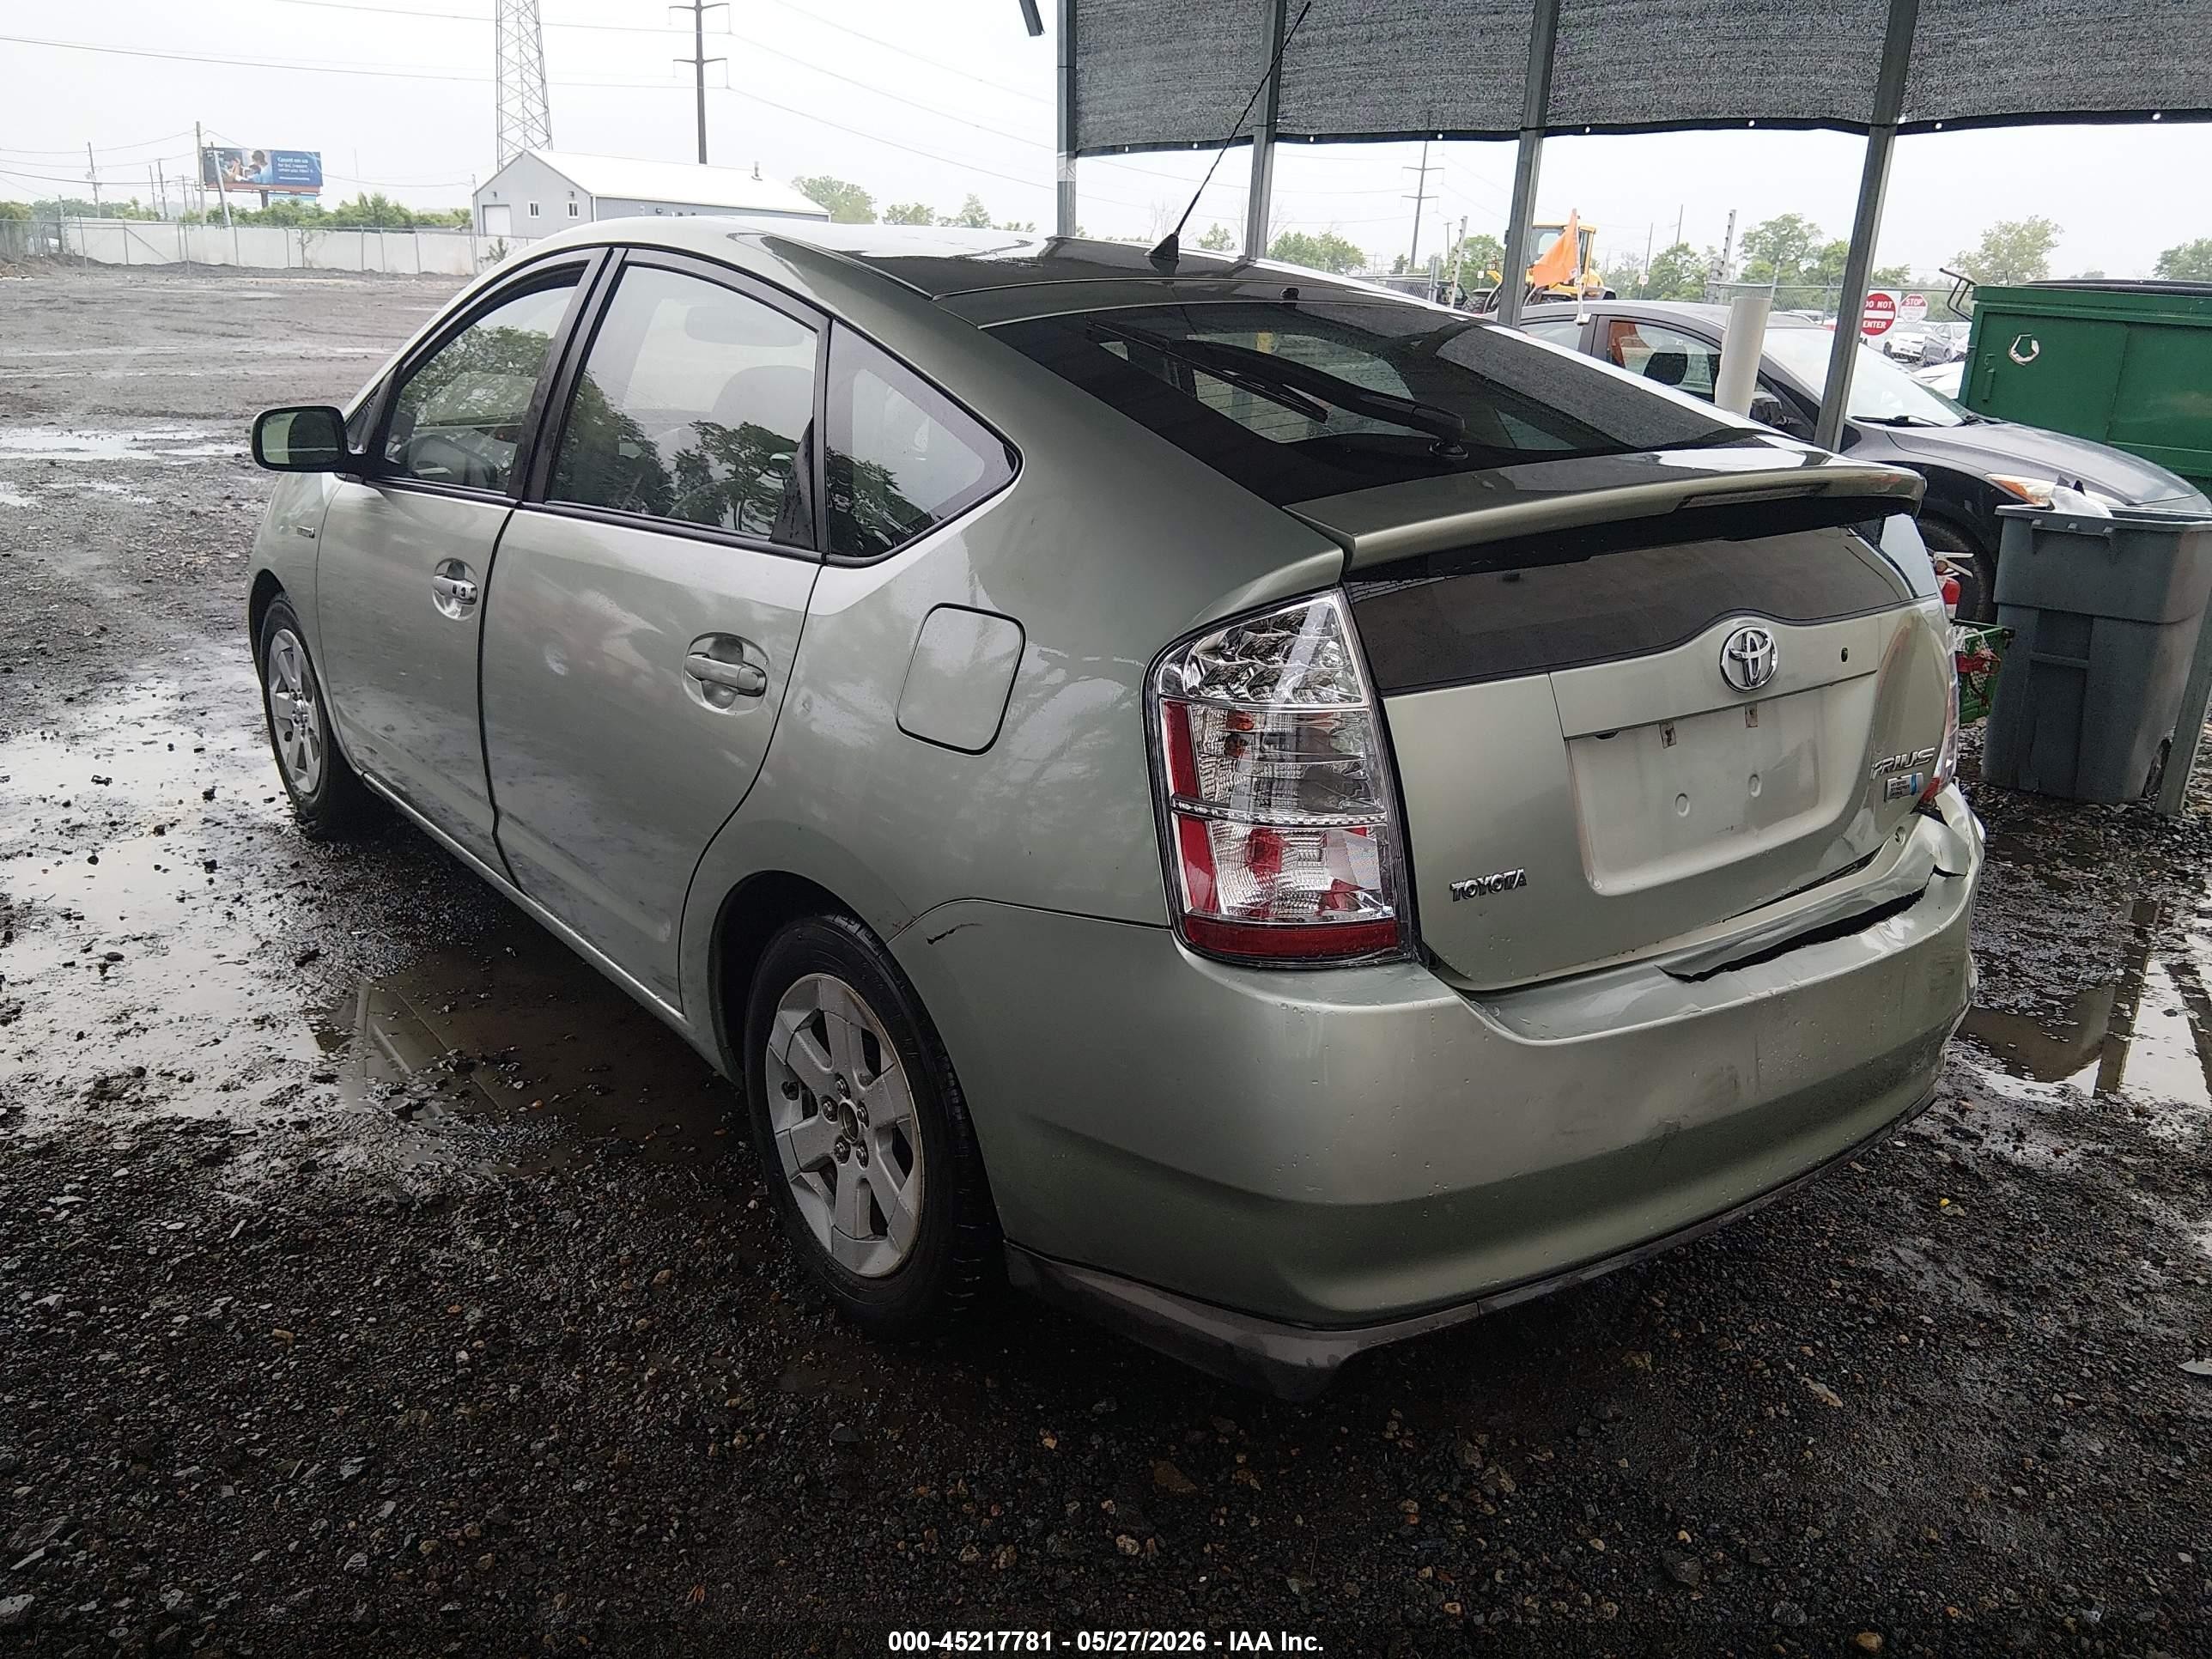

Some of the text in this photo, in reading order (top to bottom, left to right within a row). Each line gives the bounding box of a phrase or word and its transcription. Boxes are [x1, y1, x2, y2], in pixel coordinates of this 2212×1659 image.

[1876, 301, 1893, 309] NOT
[1905, 297, 1923, 306] STOP
[1863, 320, 1887, 330] ENTER
[1869, 747, 1936, 780] PRIUS
[1449, 867, 1527, 902] TOYOTA
